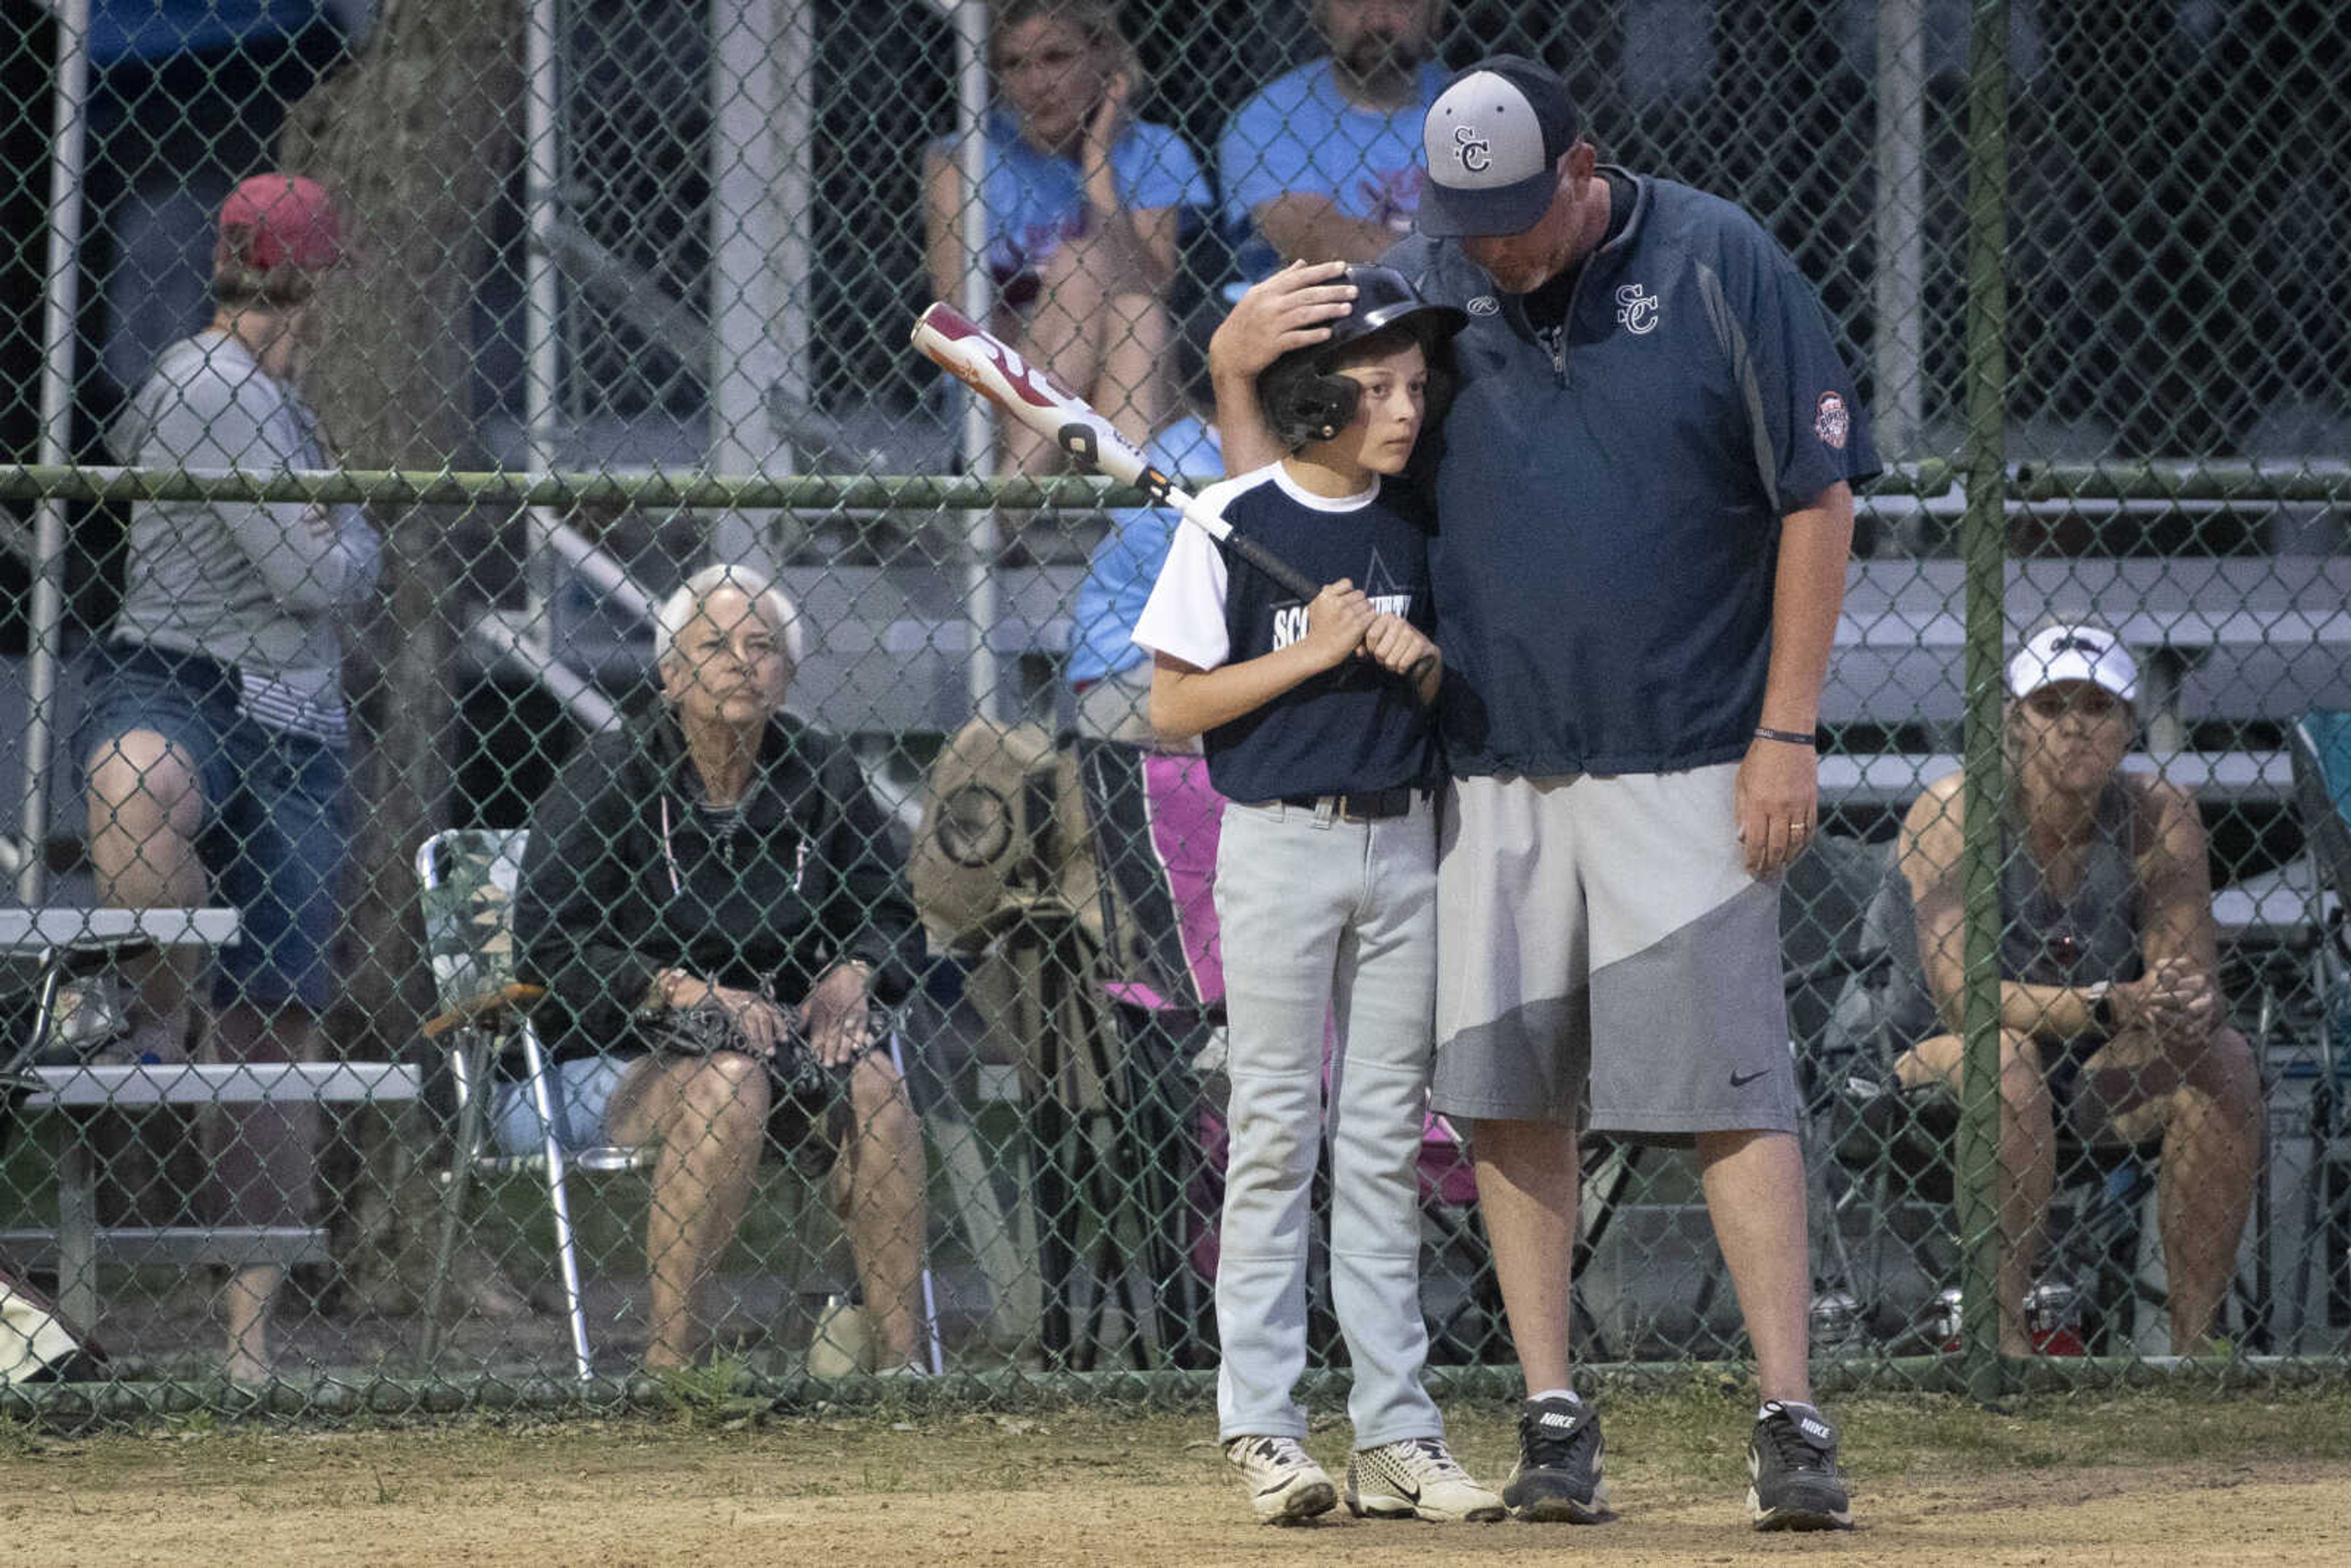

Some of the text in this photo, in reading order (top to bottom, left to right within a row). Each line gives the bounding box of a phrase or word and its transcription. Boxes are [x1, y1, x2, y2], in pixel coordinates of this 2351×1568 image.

[1454, 126, 1491, 172] SC
[1616, 283, 1658, 334] SC
[1539, 1412, 1576, 1428] NIKE
[1801, 1417, 1831, 1439] NIKE
